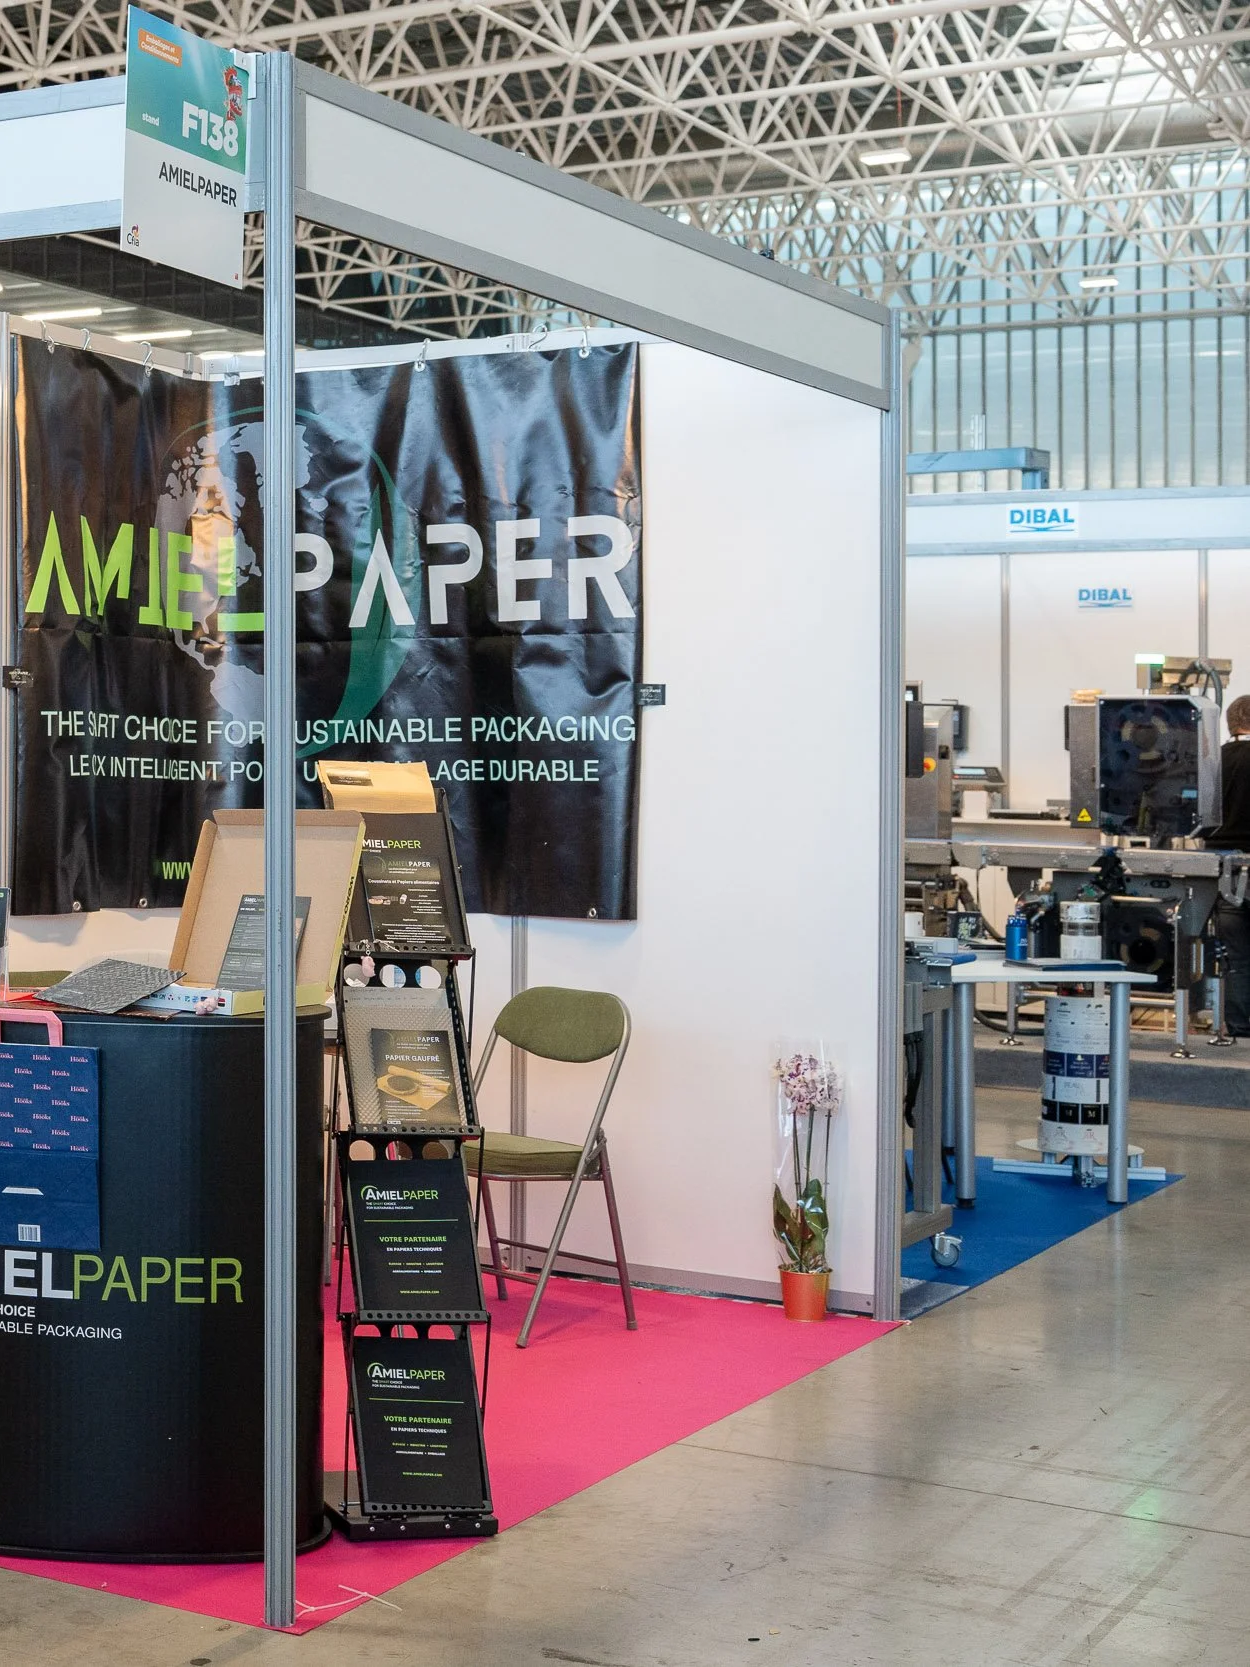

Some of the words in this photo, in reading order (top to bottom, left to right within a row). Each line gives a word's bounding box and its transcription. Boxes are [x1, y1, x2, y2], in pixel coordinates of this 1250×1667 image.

[142, 112, 159, 126] stand
[182, 100, 239, 157] F138
[158, 161, 237, 208] AMIELPAPER
[1009, 508, 1075, 525] DIBAL
[1078, 588, 1132, 601] DIBAL
[41, 710, 85, 737] THE
[207, 720, 265, 745] FOR
[295, 717, 461, 746] USTAINABLE
[471, 715, 636, 742] PACKAGING
[69, 754, 90, 777] LE
[110, 756, 222, 781] INTELLIGENT
[490, 760, 600, 782] DURABLE
[362, 839, 421, 849] MIELPAPER
[385, 1054, 410, 1062] PAPIER
[365, 1188, 439, 1200] AMIELPAPER
[38, 1323, 122, 1340] PACKAGING
[371, 1365, 446, 1381] AMIELPAPER
[384, 1415, 407, 1423] VOTRE
[409, 1416, 452, 1424] PARTENAIRE
